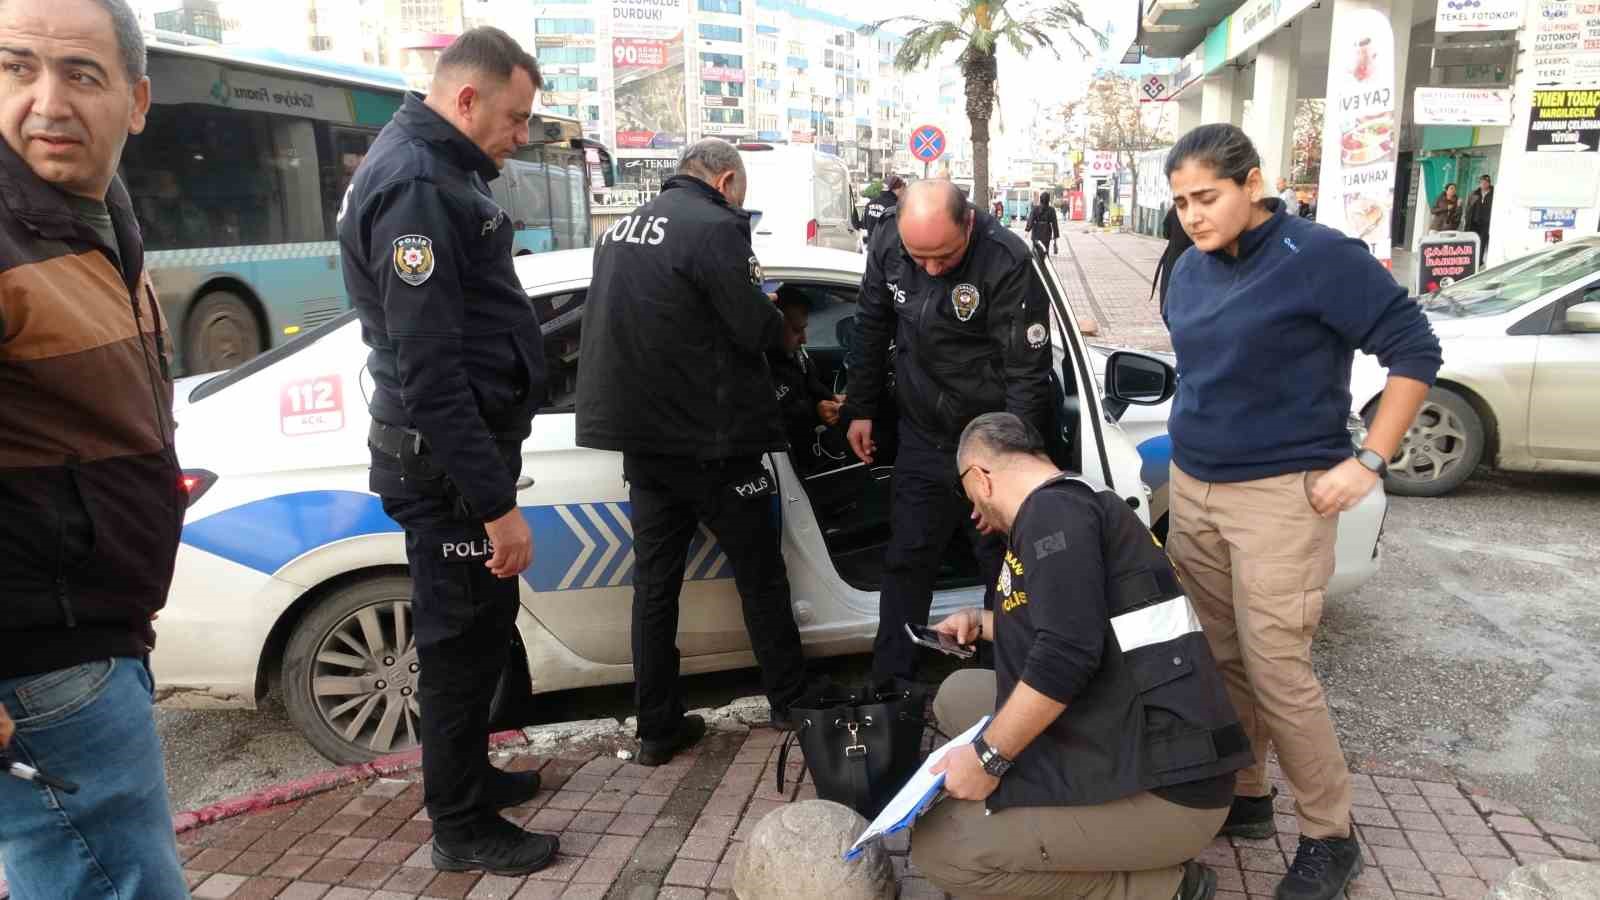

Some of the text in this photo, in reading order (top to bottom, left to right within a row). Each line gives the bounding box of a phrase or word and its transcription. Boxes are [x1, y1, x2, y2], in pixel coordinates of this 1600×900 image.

[613, 8, 662, 19] DURDUK!
[614, 46, 637, 63] 90
[287, 384, 336, 412] 112
